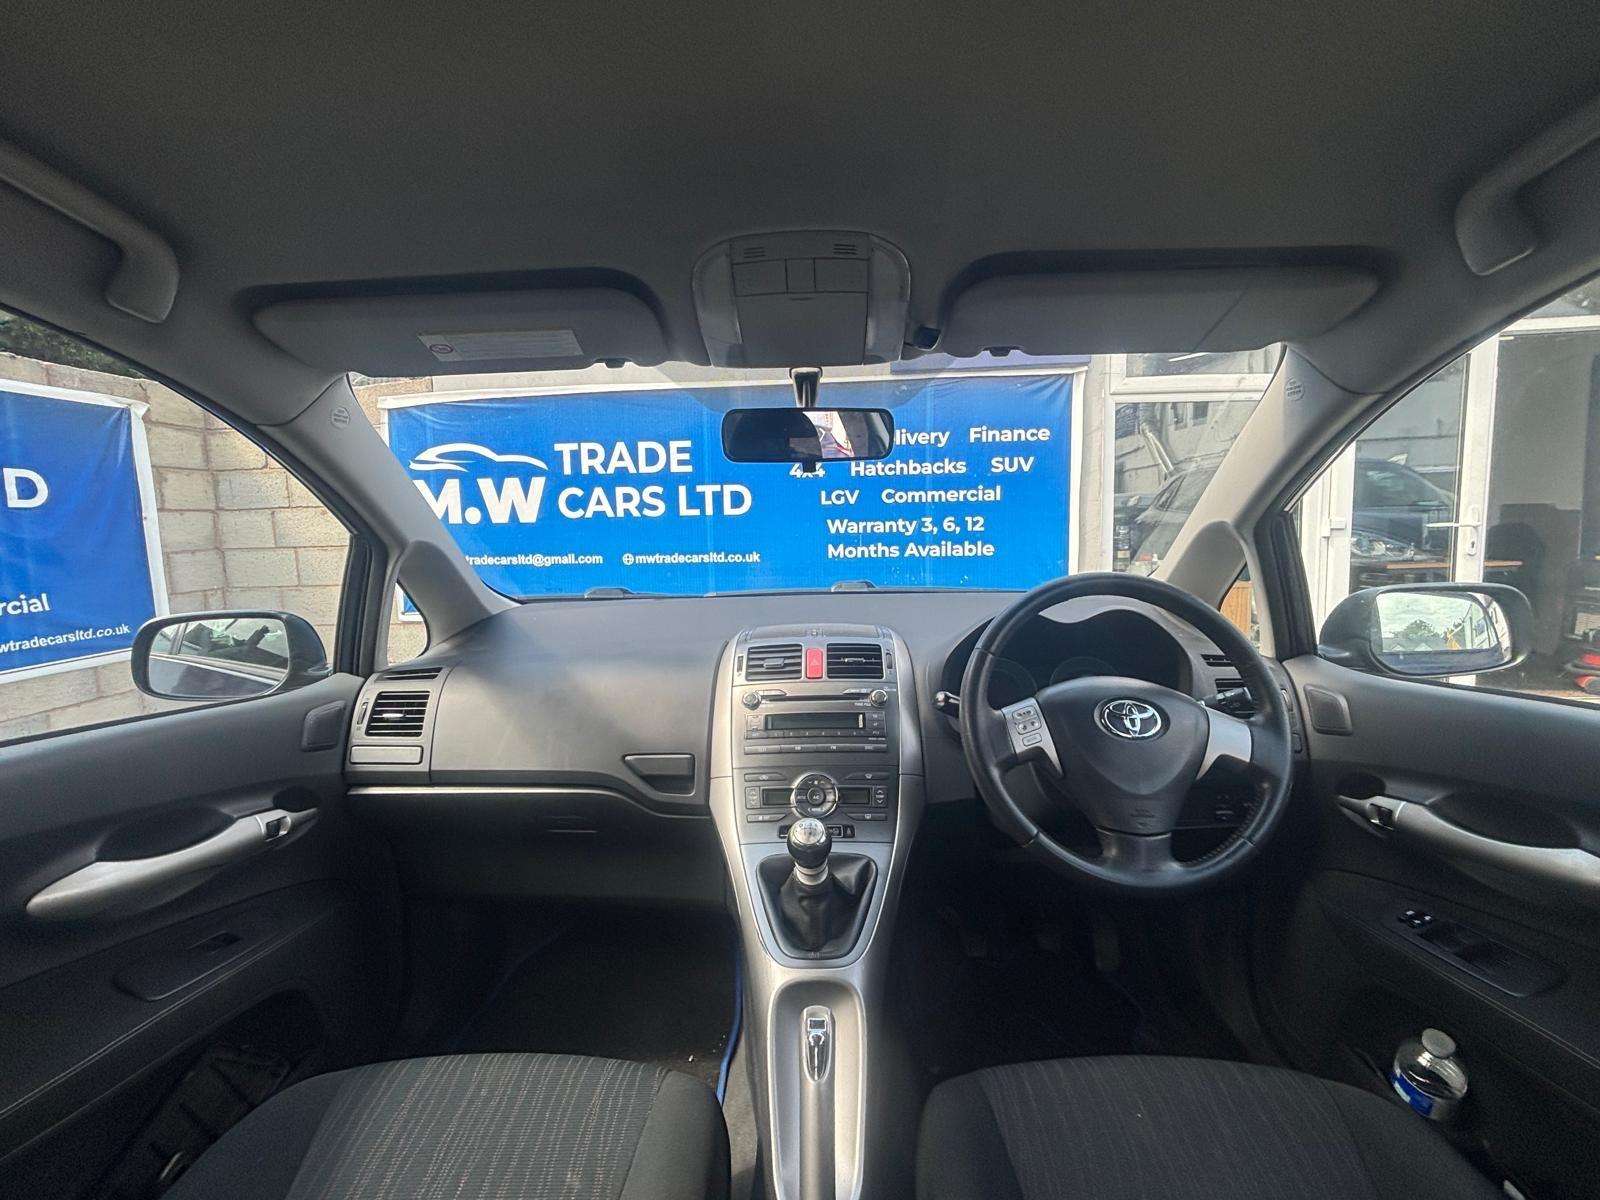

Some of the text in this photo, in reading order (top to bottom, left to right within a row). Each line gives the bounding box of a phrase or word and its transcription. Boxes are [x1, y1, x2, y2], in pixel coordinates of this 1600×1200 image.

[894, 425, 1051, 449] livery Finance
[553, 440, 693, 476] TRADE
[789, 456, 1035, 478] 44 Hatchbacks SUV
[412, 476, 546, 524] M.W
[557, 484, 752, 519] CARS LTD
[820, 484, 1001, 505] LGV Commercial
[826, 516, 985, 537] Warranty 3, 6, 12
[635, 551, 761, 564] mwtradecarsltd.co.uk
[827, 540, 995, 559] Months Available
